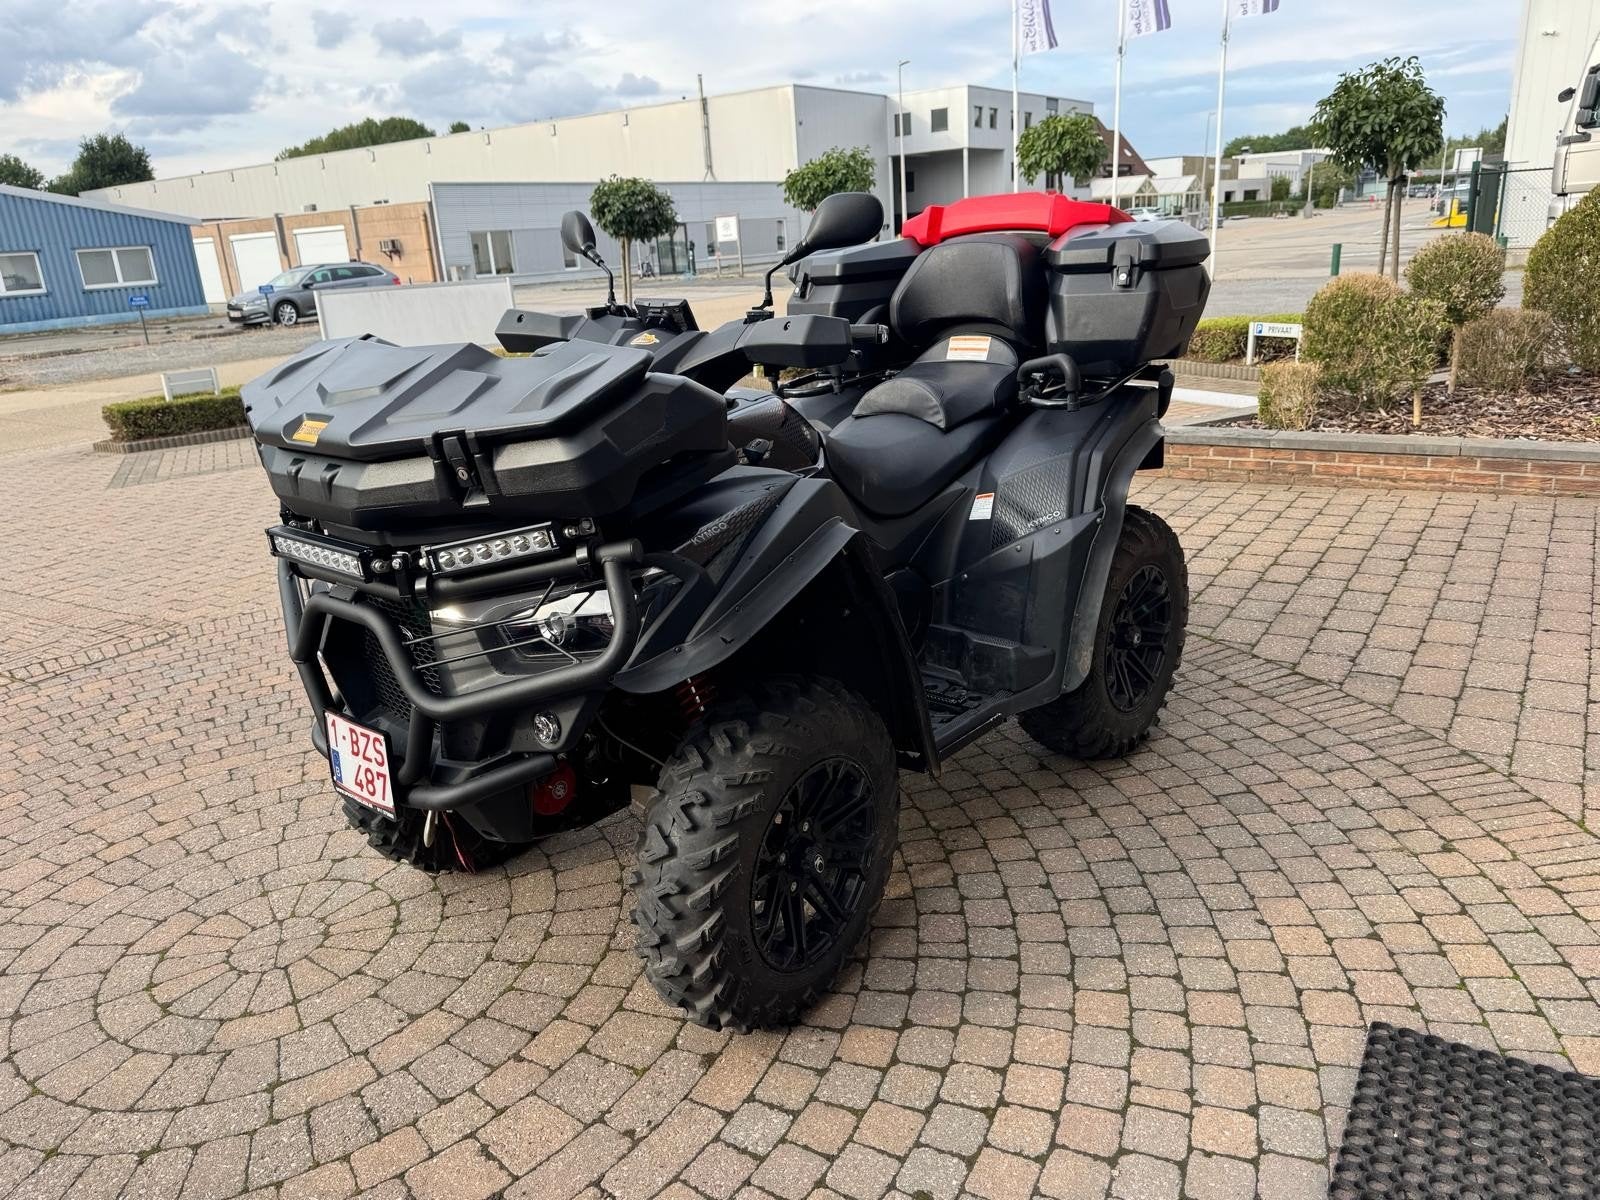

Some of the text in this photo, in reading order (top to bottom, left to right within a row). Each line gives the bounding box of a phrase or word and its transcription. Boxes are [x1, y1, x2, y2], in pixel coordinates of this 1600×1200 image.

[1268, 326, 1292, 334] PRIVAAT
[1027, 510, 1061, 528] KYMCO
[690, 521, 728, 545] KYMCO
[354, 764, 387, 802] 487
